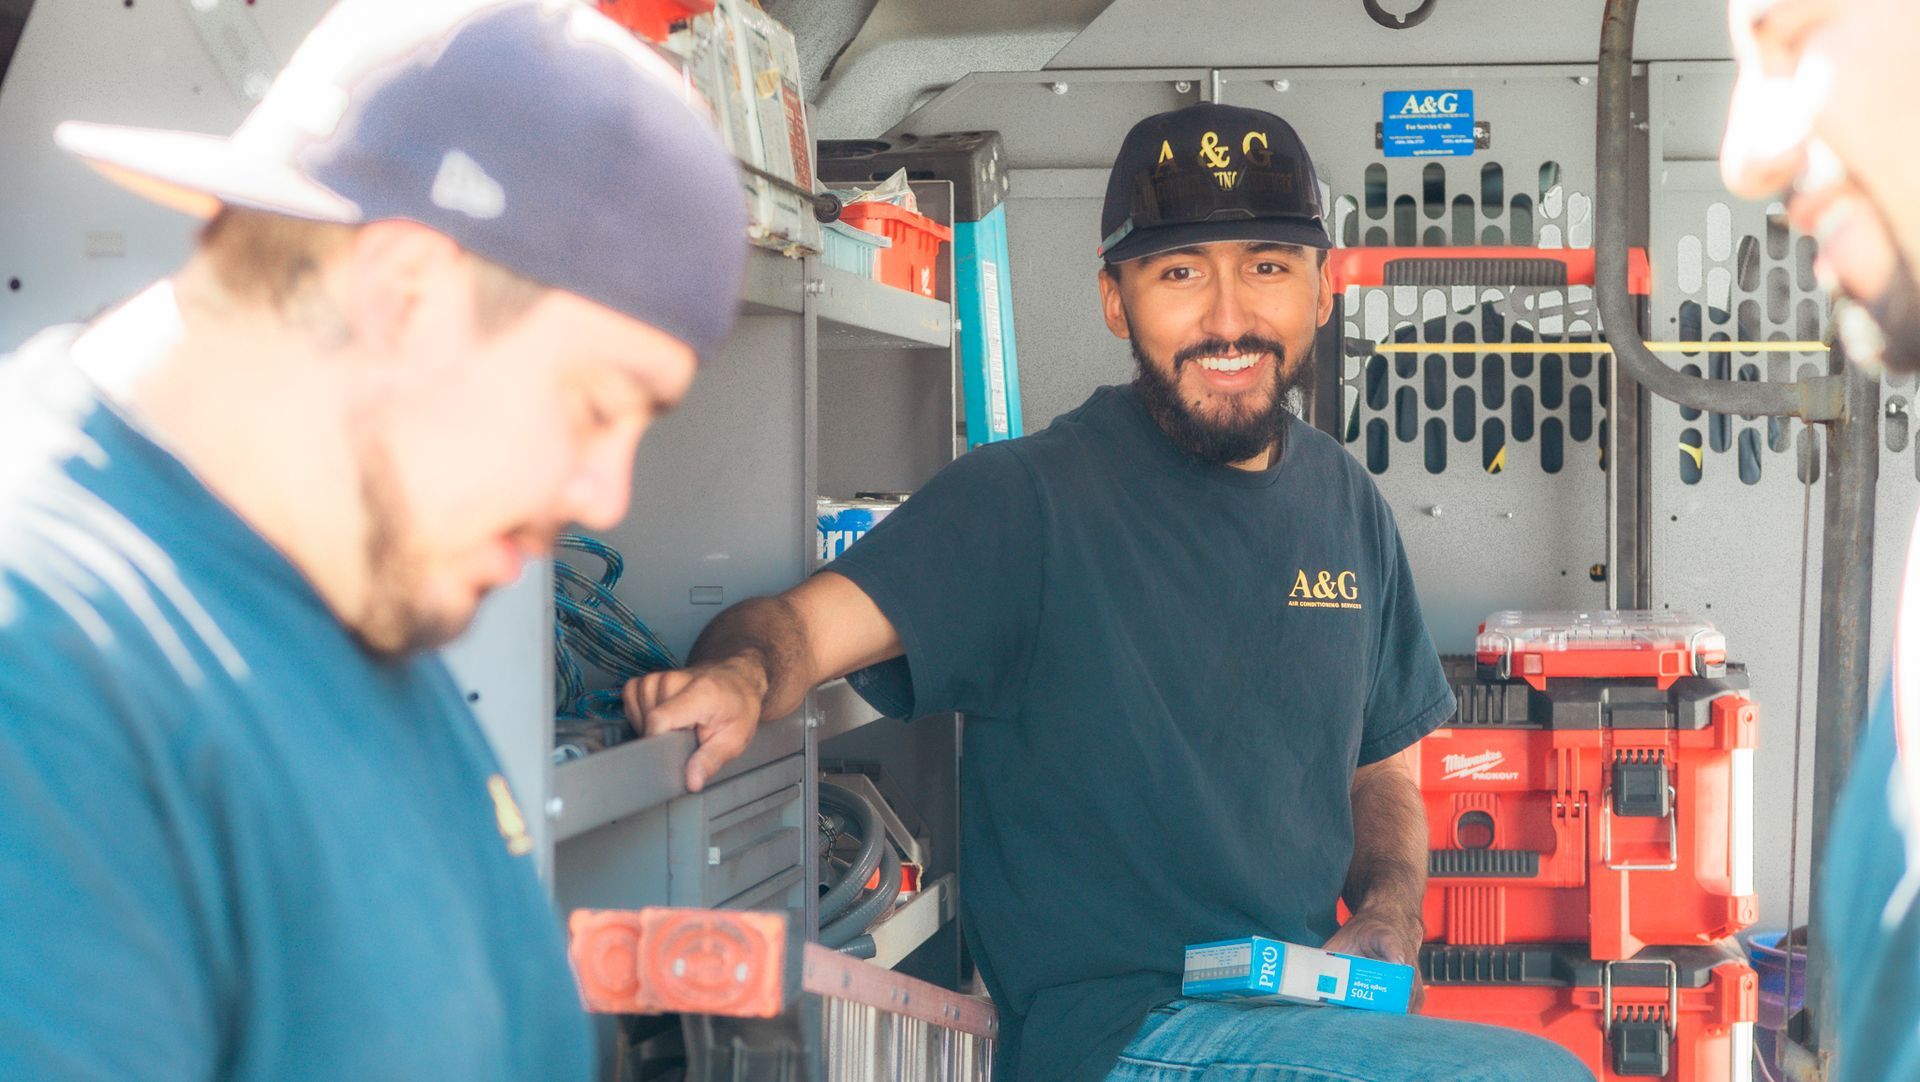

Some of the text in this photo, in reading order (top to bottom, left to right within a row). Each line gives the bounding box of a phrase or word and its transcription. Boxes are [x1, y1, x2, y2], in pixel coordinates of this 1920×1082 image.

[1400, 92, 1458, 114] A&G
[1289, 569, 1358, 600] A&G
[1441, 749, 1502, 773] Milwaukee
[1472, 772, 1519, 780] PACKOUT
[1258, 946, 1278, 988] PRO
[1350, 988, 1374, 1001] T705
[1353, 981, 1387, 993] Single Stage
